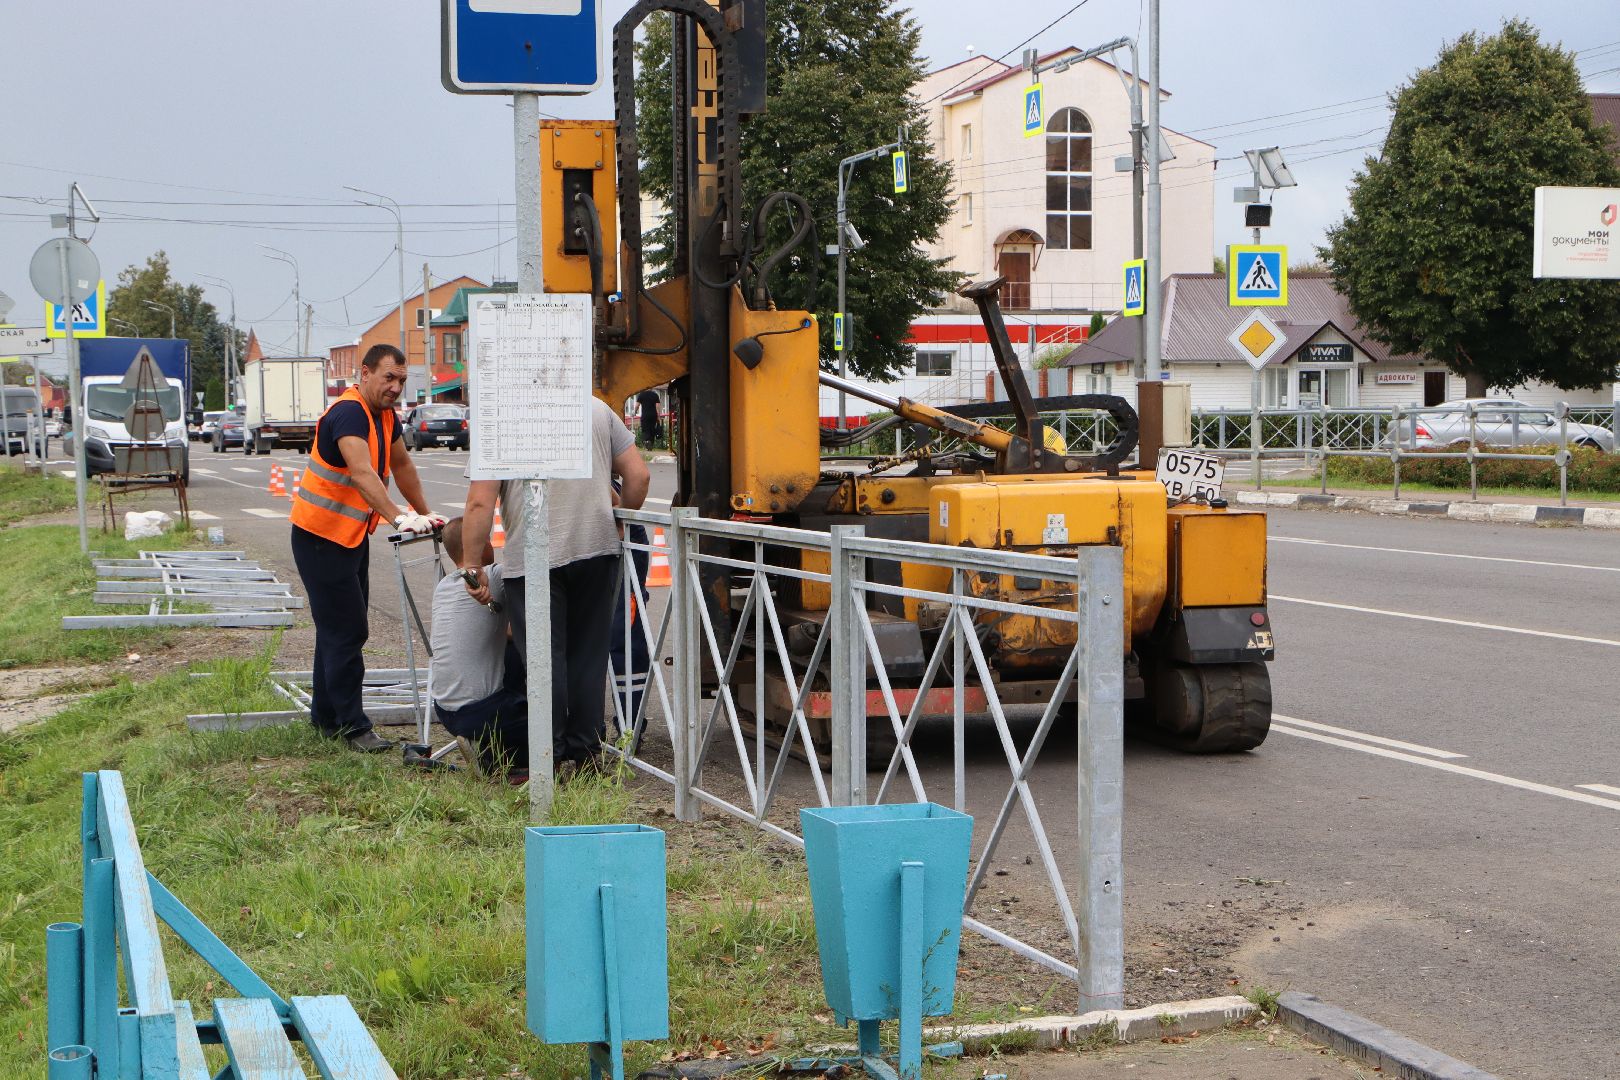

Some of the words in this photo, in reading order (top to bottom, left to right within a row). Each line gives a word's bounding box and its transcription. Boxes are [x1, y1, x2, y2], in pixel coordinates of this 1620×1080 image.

[1552, 237, 1609, 247] документы
[1309, 347, 1342, 356] VIVAT
[1166, 453, 1217, 479] 0575
